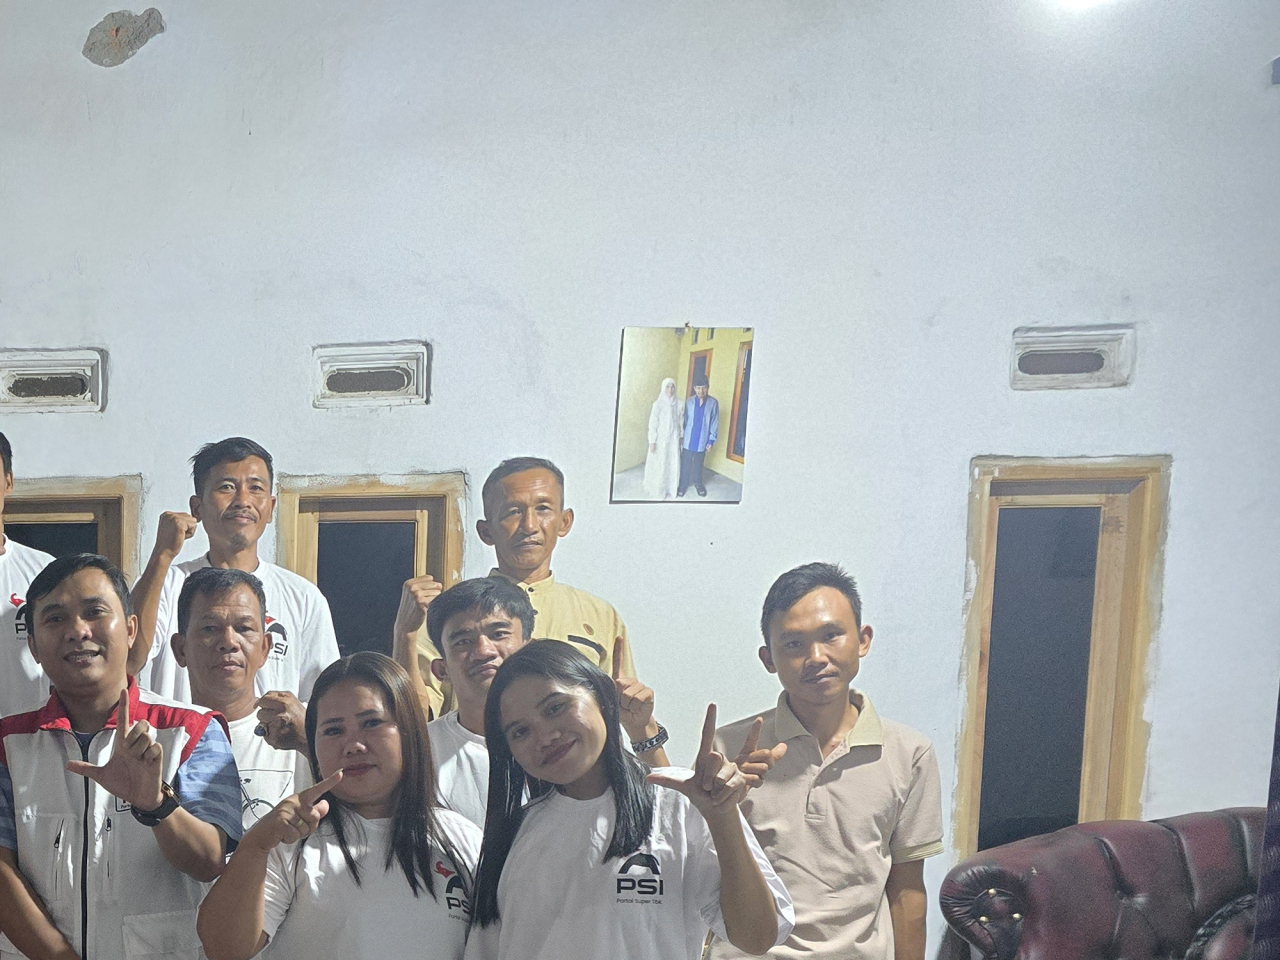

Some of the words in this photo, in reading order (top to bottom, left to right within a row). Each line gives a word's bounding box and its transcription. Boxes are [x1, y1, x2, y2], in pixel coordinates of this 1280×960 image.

[274, 642, 288, 656] SI
[617, 878, 664, 895] PSI
[446, 896, 471, 915] PS
